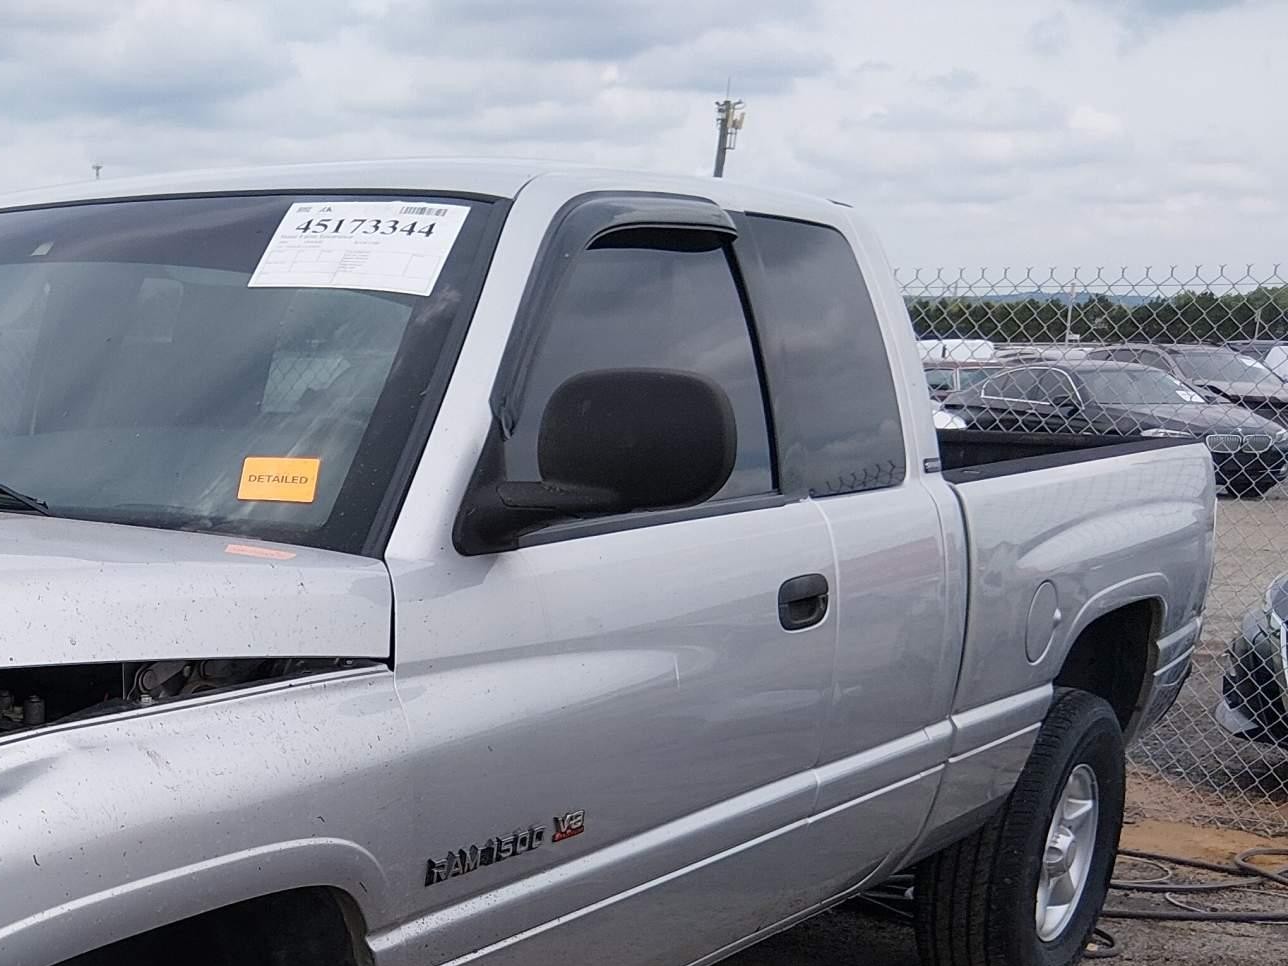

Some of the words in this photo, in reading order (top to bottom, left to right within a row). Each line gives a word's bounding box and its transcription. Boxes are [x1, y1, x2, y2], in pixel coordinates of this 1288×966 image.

[296, 218, 436, 237] 45173344
[248, 474, 309, 485] DETAILED
[426, 845, 481, 886] RAM
[492, 825, 546, 863] 1500
